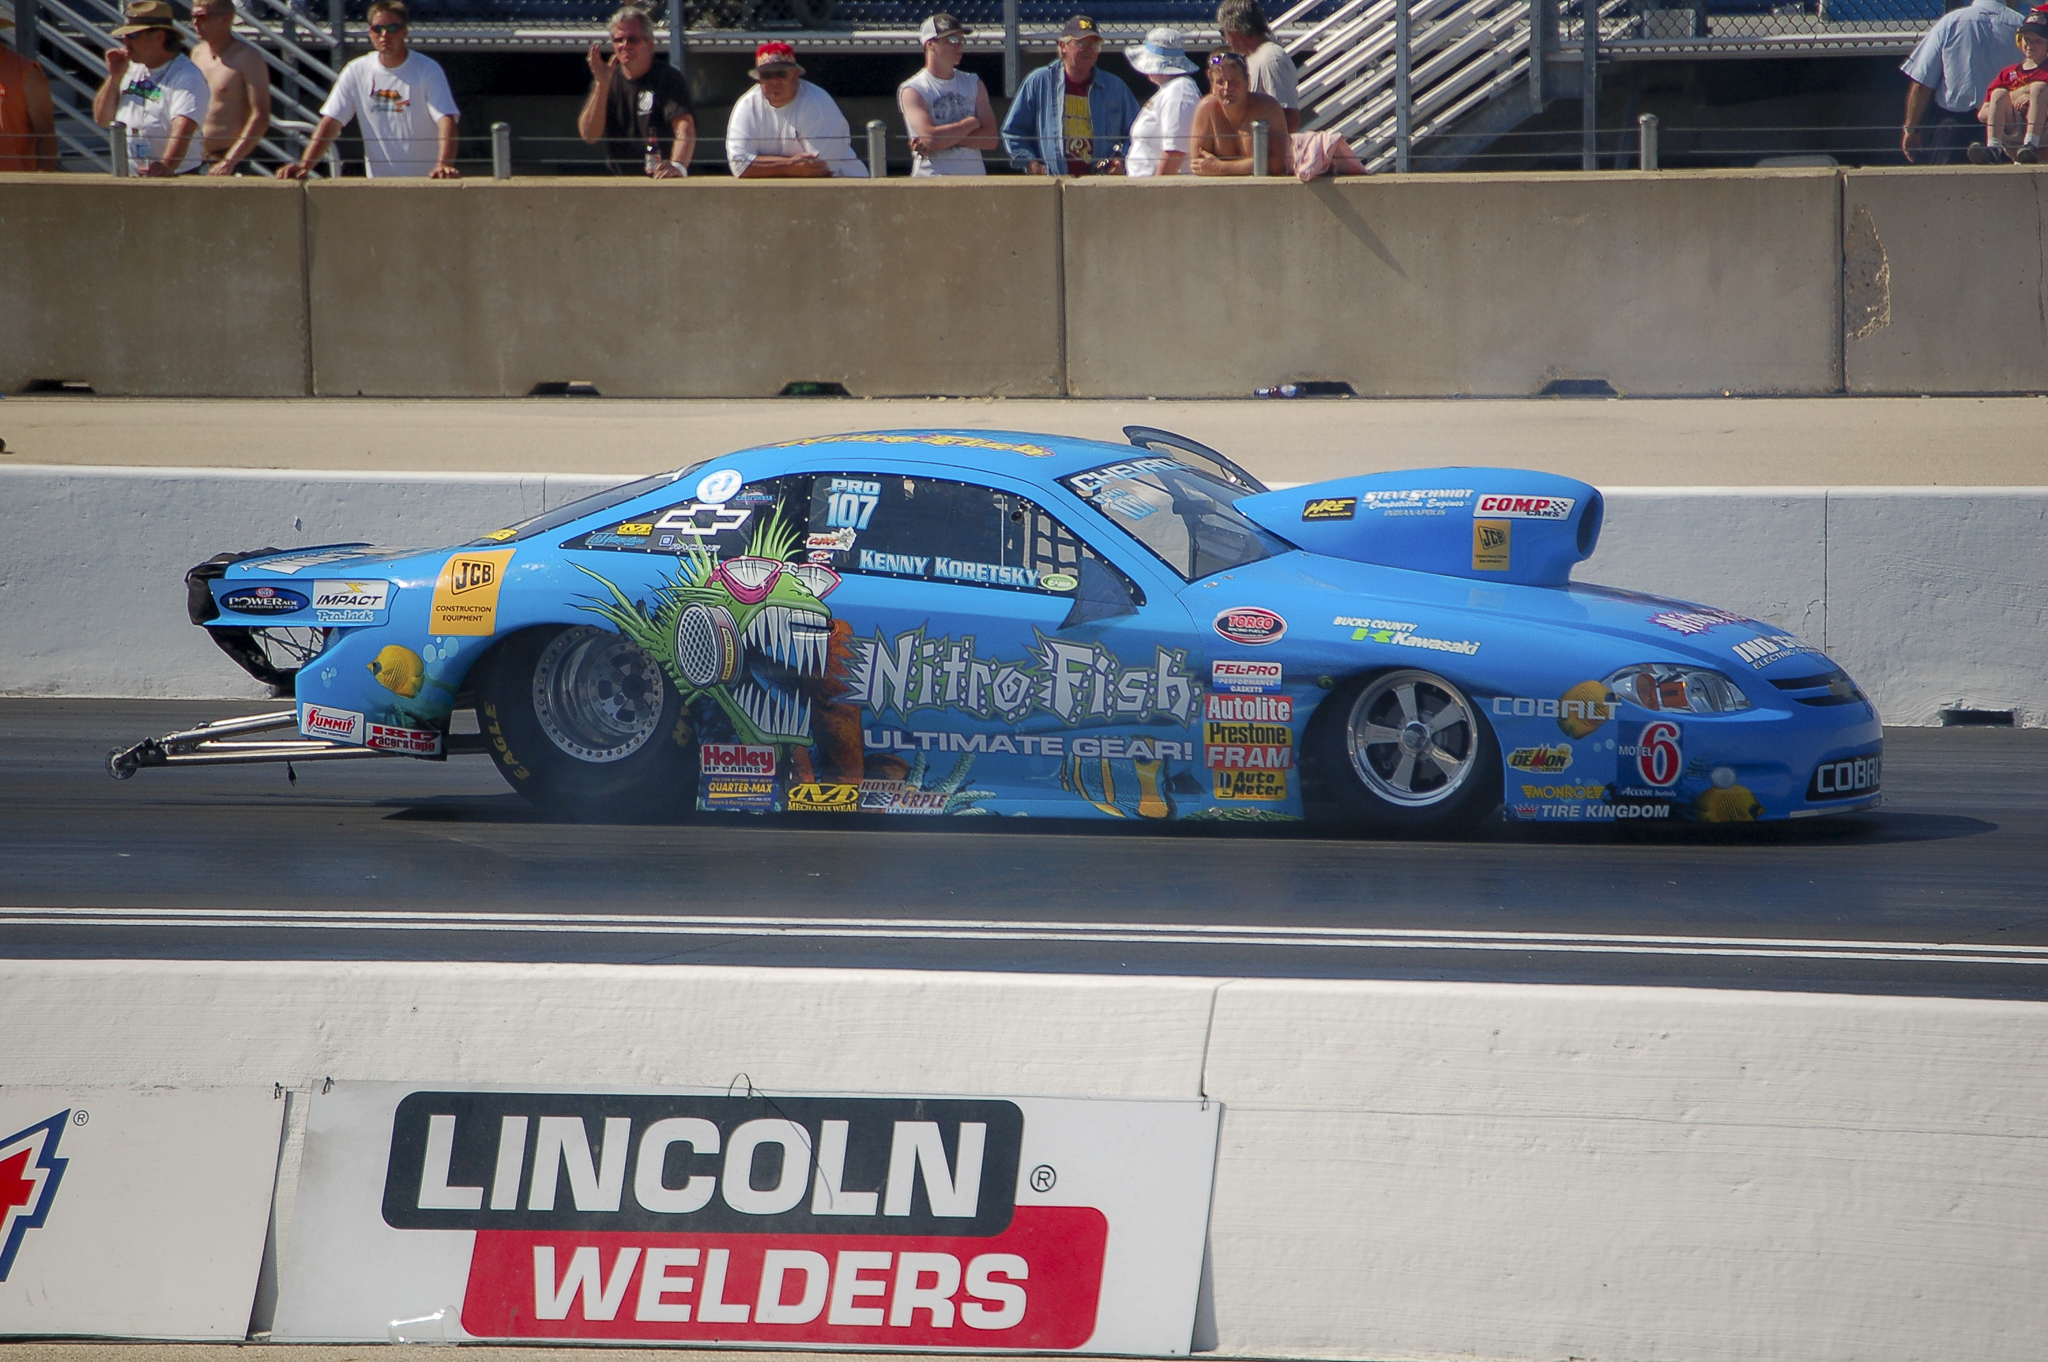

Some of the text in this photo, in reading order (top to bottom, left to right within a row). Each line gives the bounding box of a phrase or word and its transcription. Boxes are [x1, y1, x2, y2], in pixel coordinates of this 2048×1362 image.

[830, 478, 881, 495] PRO
[1090, 487, 1129, 504] PRO
[826, 493, 879, 530] 107
[1368, 499, 1465, 510] Competition Engines
[1383, 509, 1447, 517] INDIANAPOLIS
[1481, 497, 1551, 512] COMP
[1526, 510, 1561, 518] CAMS
[1483, 529, 1505, 547] JCB
[456, 562, 492, 590] JCB
[859, 548, 1041, 588] KENNY KORETSKY
[316, 595, 383, 606] IMPACT
[1228, 615, 1274, 630] TORCO
[1333, 616, 1418, 632] BUCKS COUNTY
[1391, 632, 1481, 656] Kawasaki
[1752, 648, 1796, 670] ELECTRIC
[846, 633, 1199, 723] Nitro Fish
[1214, 664, 1280, 676] FEL-PRO
[1219, 678, 1275, 687] PERFORMANCE
[1207, 695, 1291, 721] Autolite
[1493, 697, 1622, 720] COBALT
[484, 701, 530, 780] EAGLE
[1209, 722, 1287, 745] Prestone
[863, 729, 1193, 761] ULTIMATE GEAR!
[1618, 721, 1682, 786] MOTEL 6
[703, 746, 773, 773] Holley
[1207, 746, 1291, 768] FRAM
[1511, 747, 1567, 767] DEMON
[1235, 771, 1276, 784] Auto
[1817, 757, 1882, 793] COBAL
[708, 782, 773, 794] QUARTER-MAX
[861, 781, 906, 791] ROYAL
[1231, 783, 1284, 797] Meter
[1533, 785, 1597, 799] MONROE
[1621, 787, 1677, 797] ACCOR hotels
[787, 801, 858, 812] MECHANIX WEAR
[889, 790, 948, 808] PURPLE
[1542, 804, 1670, 818] TIRE KINGDOM
[417, 1113, 988, 1219] LINCOLN
[533, 1245, 1030, 1332] WELDERS
